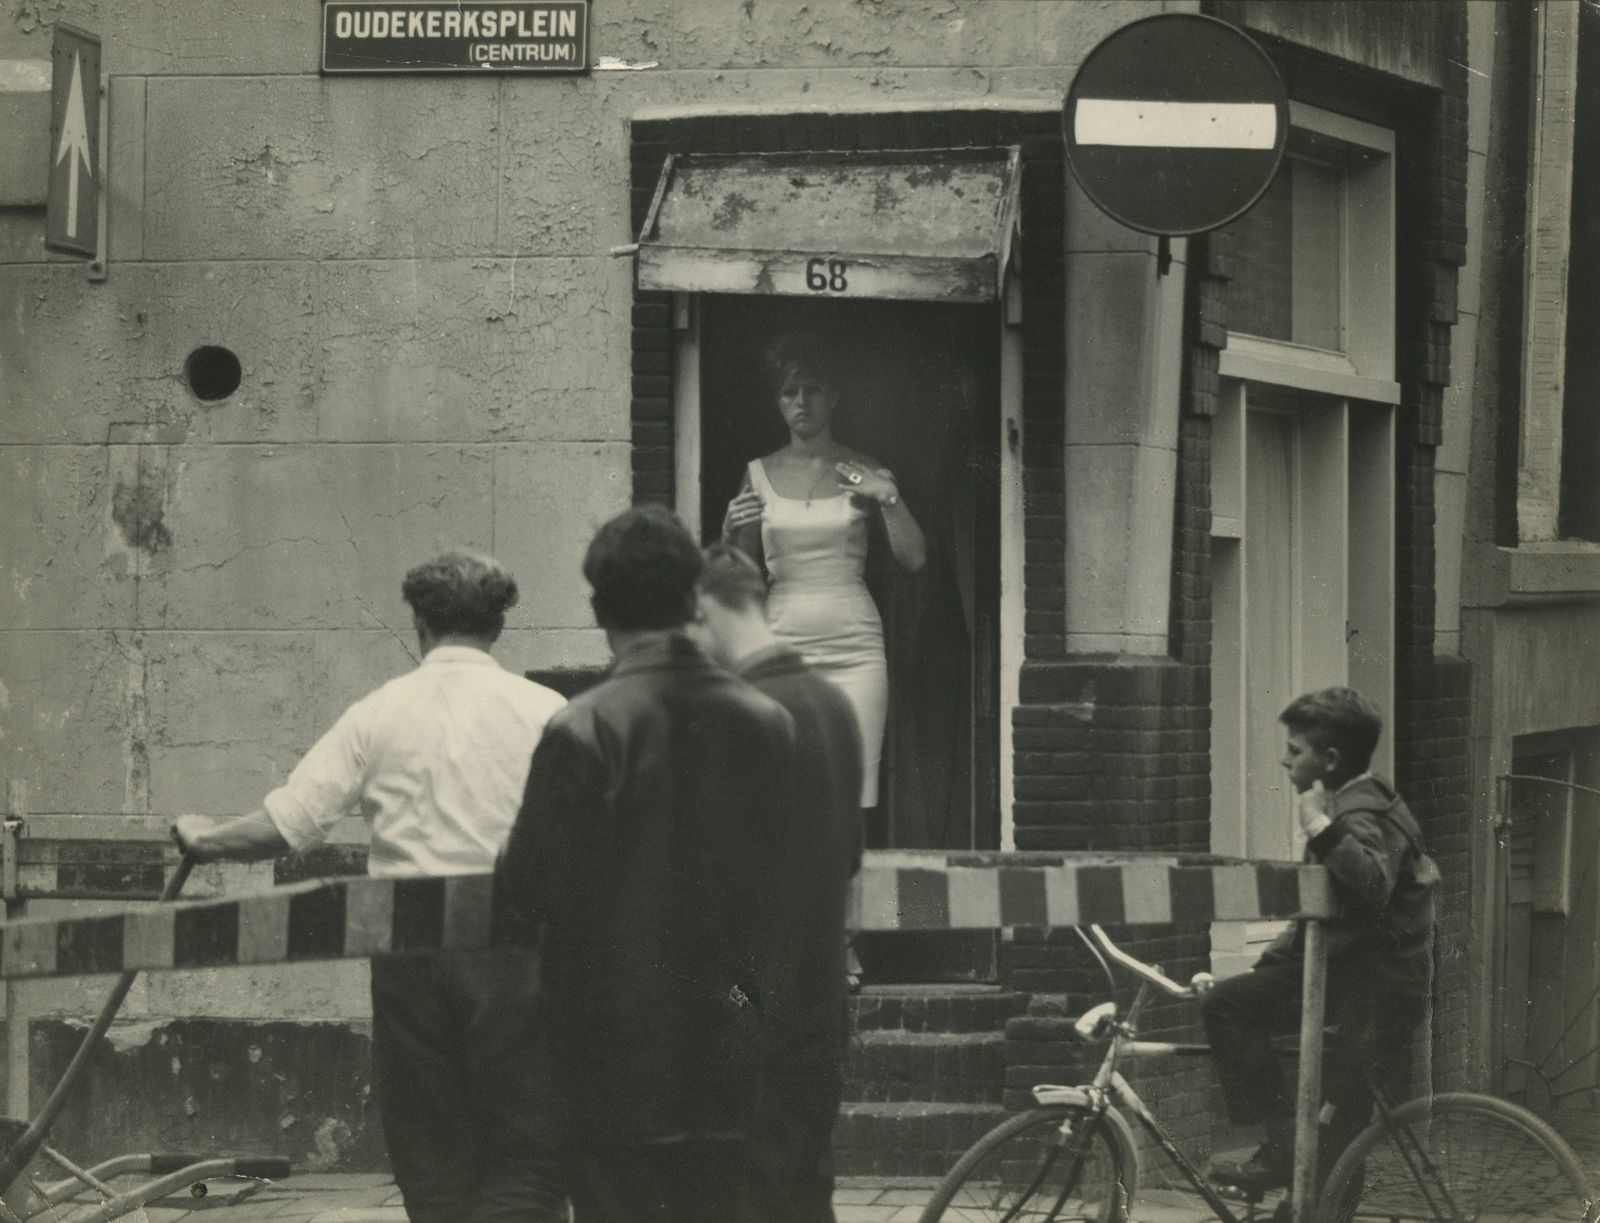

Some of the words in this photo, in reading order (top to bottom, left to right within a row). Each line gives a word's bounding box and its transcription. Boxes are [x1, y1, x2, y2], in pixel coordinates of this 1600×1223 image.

[335, 10, 577, 38] OUDEKERKSPLEIN
[469, 43, 577, 62] (CENTRUM)
[806, 258, 848, 292] 68
